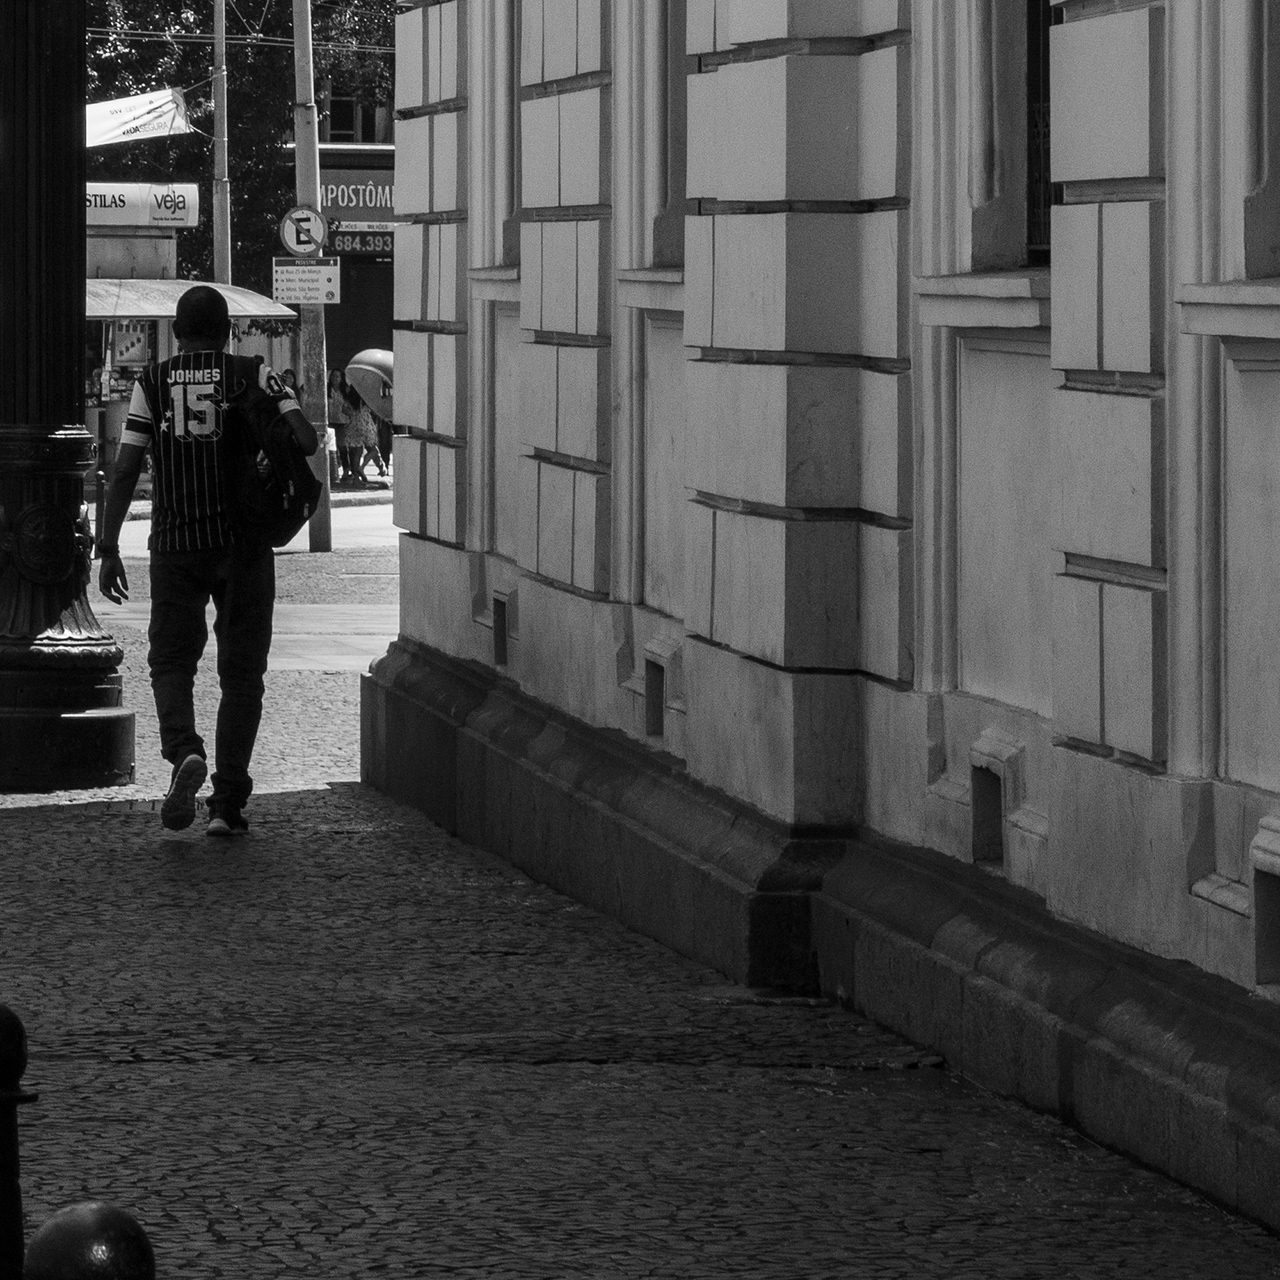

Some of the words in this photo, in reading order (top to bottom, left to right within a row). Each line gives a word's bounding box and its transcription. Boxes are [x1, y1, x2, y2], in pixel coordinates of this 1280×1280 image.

[153, 190, 187, 215] veja
[320, 180, 394, 208] POSTÔM
[167, 368, 221, 384] JOHNES
[171, 384, 220, 440] 15
